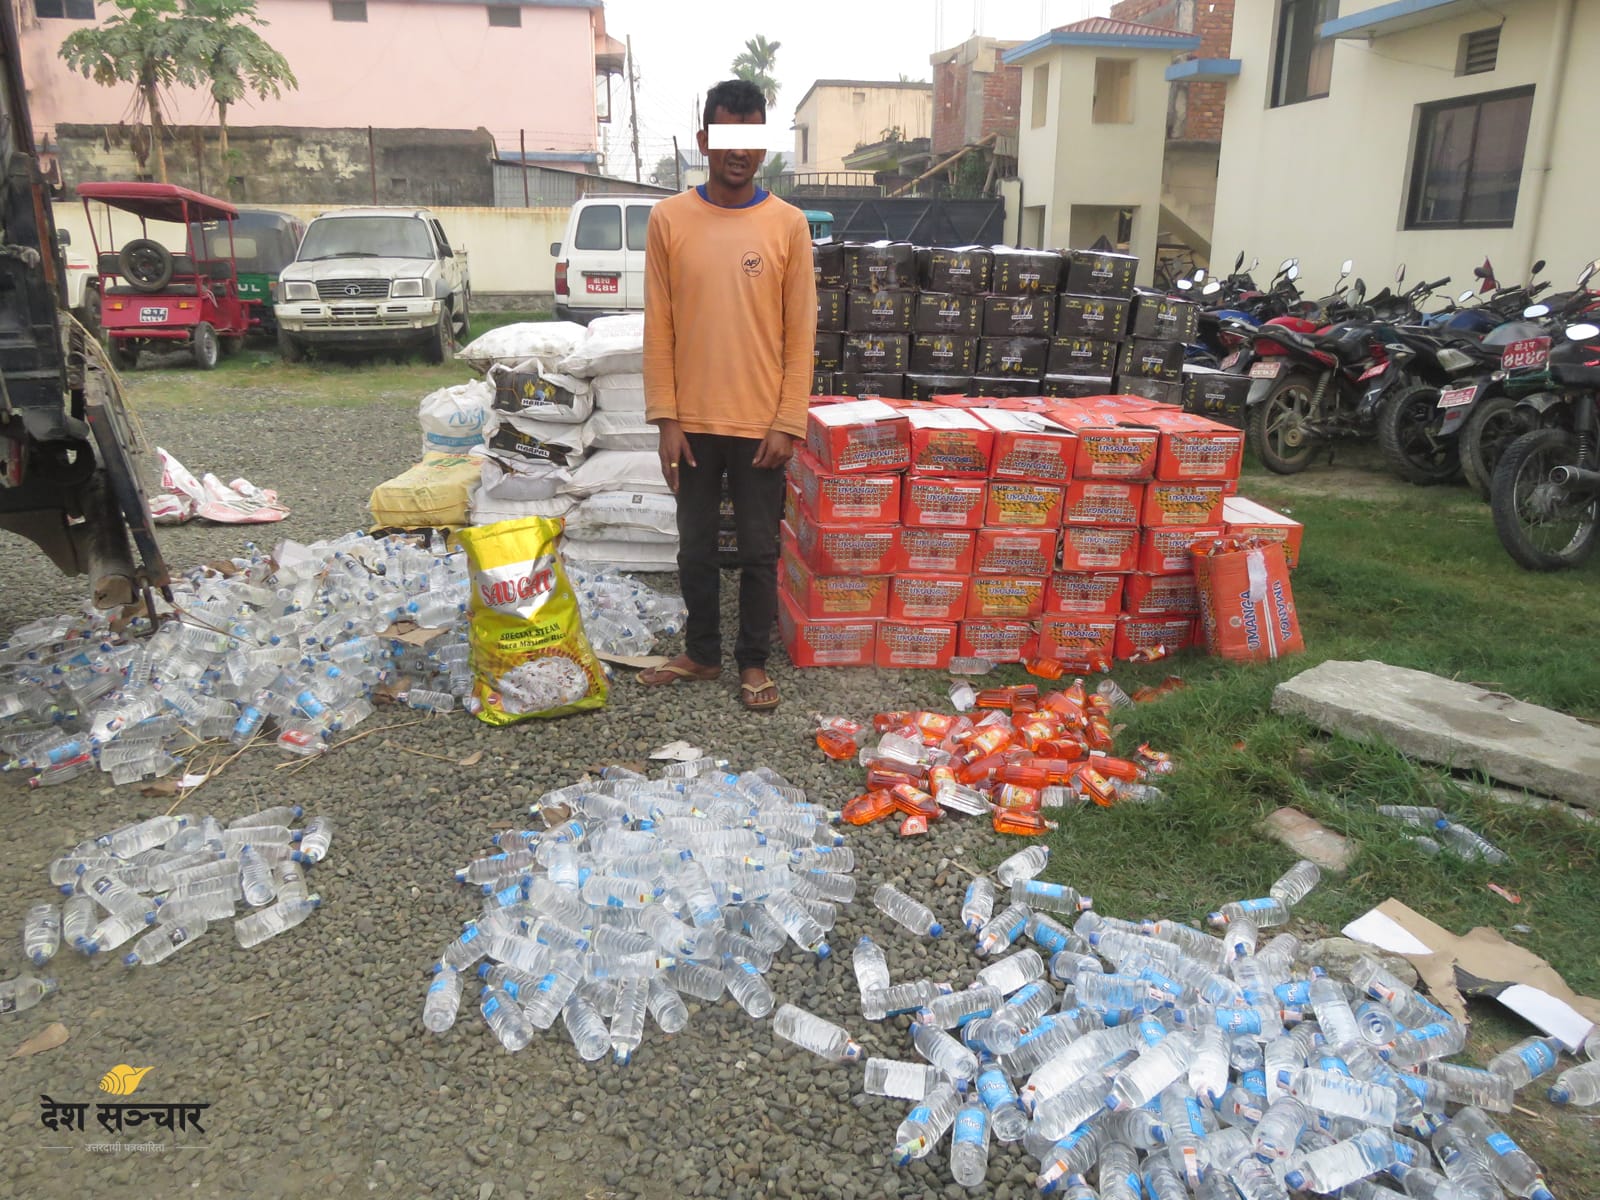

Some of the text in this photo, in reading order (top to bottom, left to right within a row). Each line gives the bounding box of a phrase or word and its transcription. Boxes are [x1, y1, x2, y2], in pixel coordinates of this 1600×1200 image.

[1098, 444, 1140, 453] UMANGA
[837, 486, 878, 494] UMANGA
[1006, 493, 1045, 502] UMANGA
[1168, 494, 1207, 502] UMANGA
[481, 568, 553, 607] SAUGAT
[1273, 581, 1292, 641] UMANGA
[1240, 590, 1260, 650] UMANGA
[500, 623, 561, 641] SPECIAL STEAM
